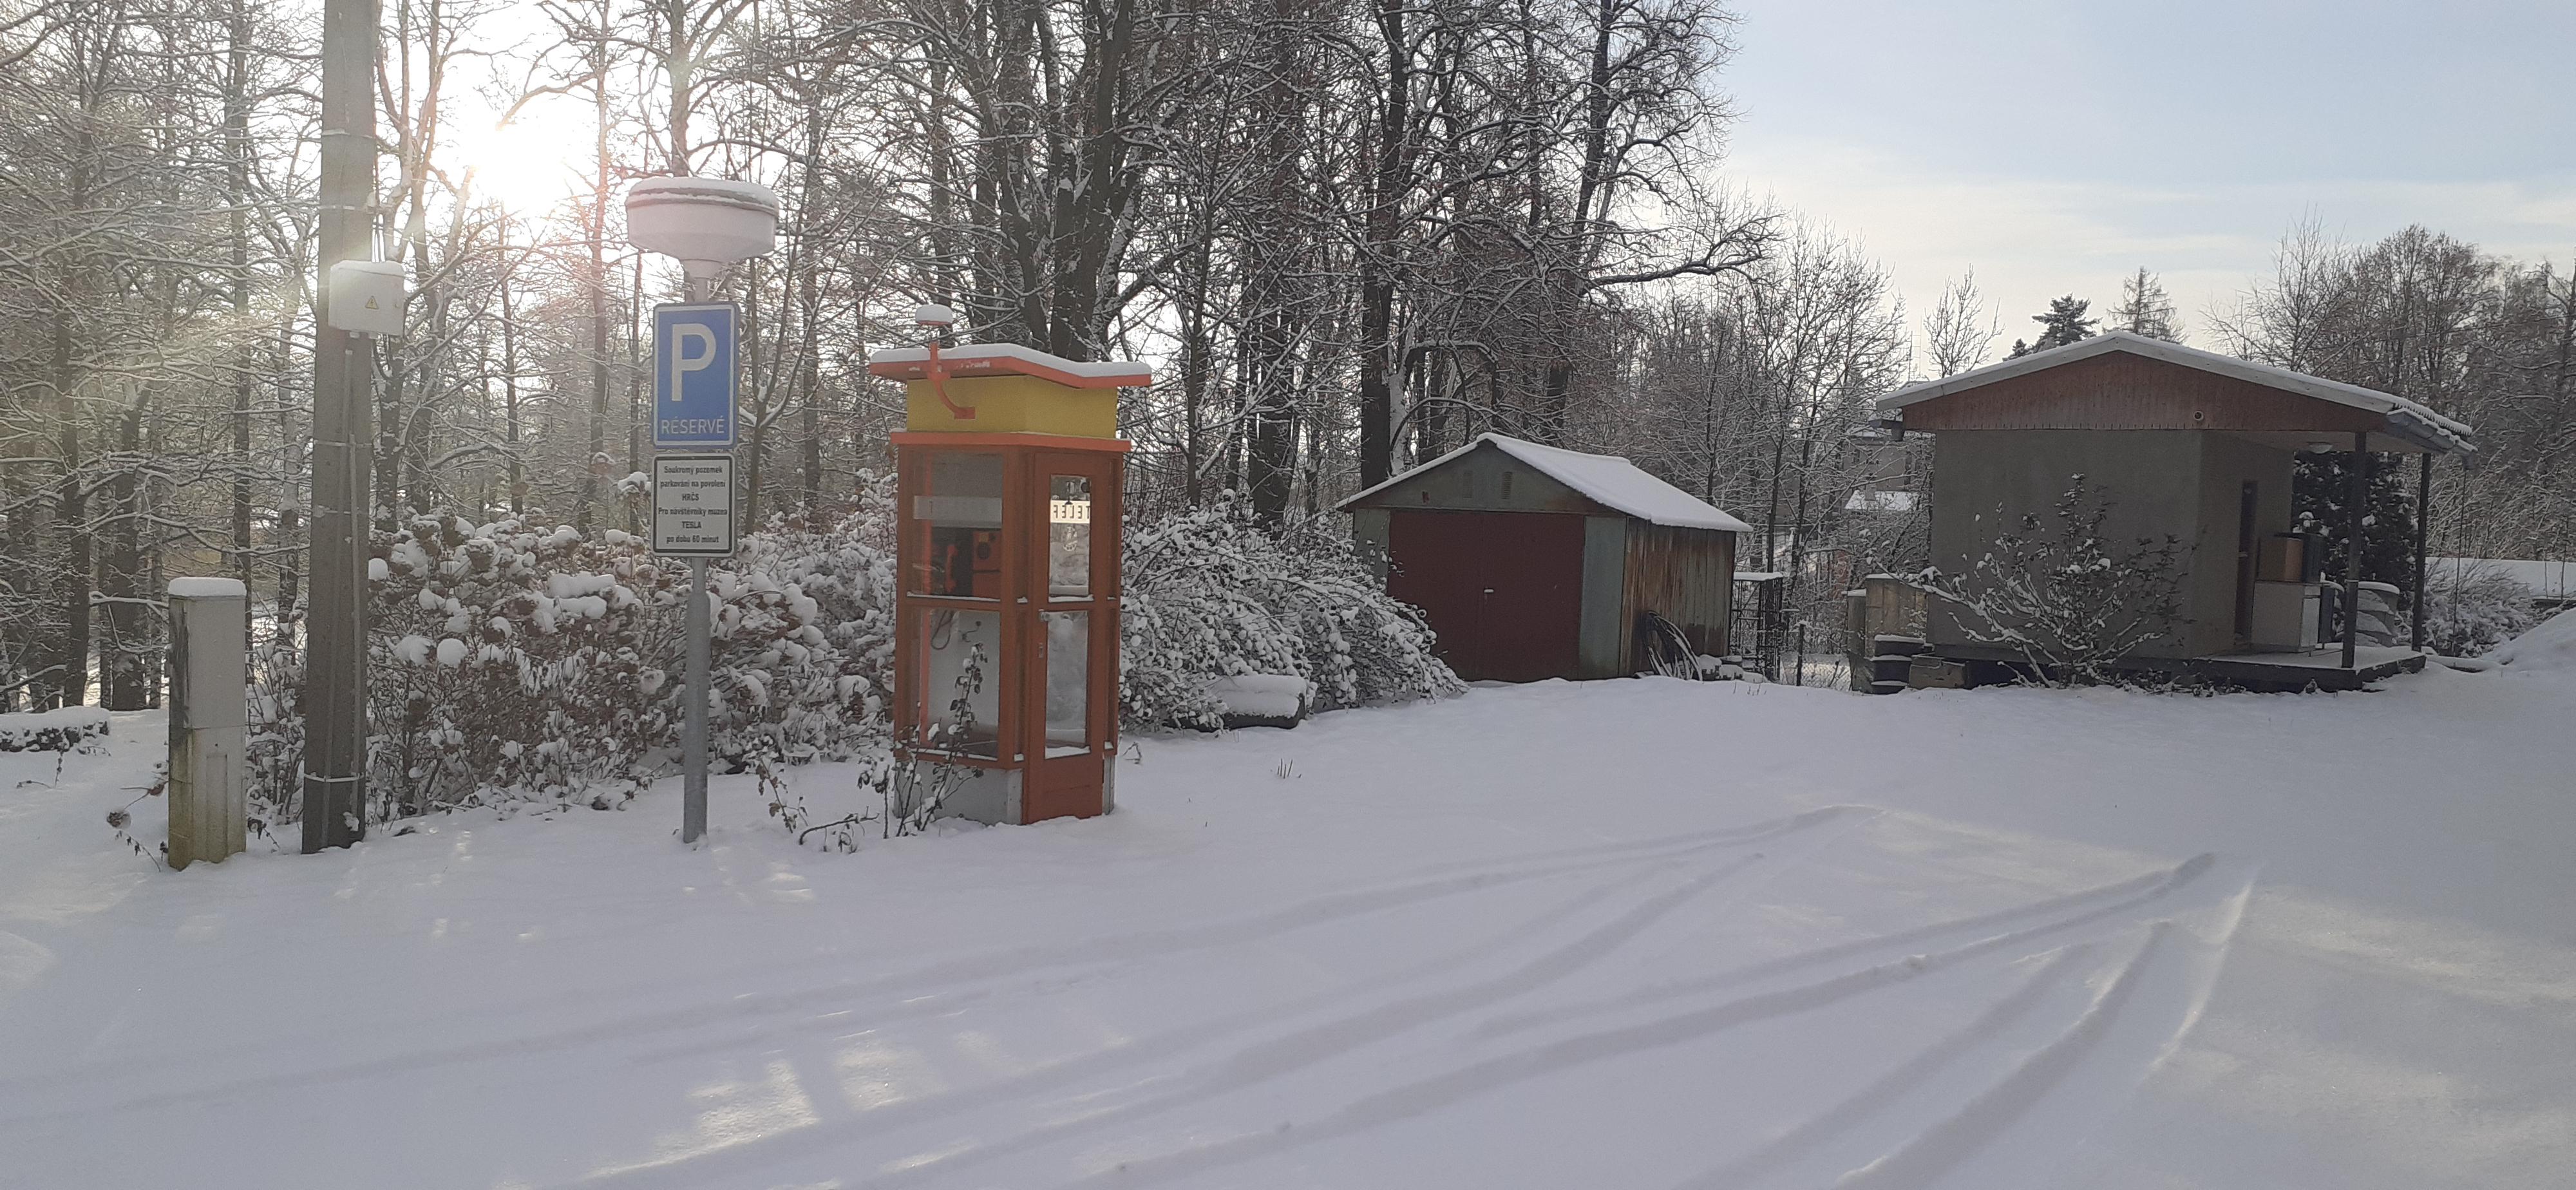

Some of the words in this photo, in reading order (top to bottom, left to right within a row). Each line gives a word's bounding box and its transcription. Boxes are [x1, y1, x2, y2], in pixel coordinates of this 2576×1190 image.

[672, 323, 716, 401] P
[661, 415, 724, 434] RÉSERVÉ
[696, 466, 723, 475] pozemek
